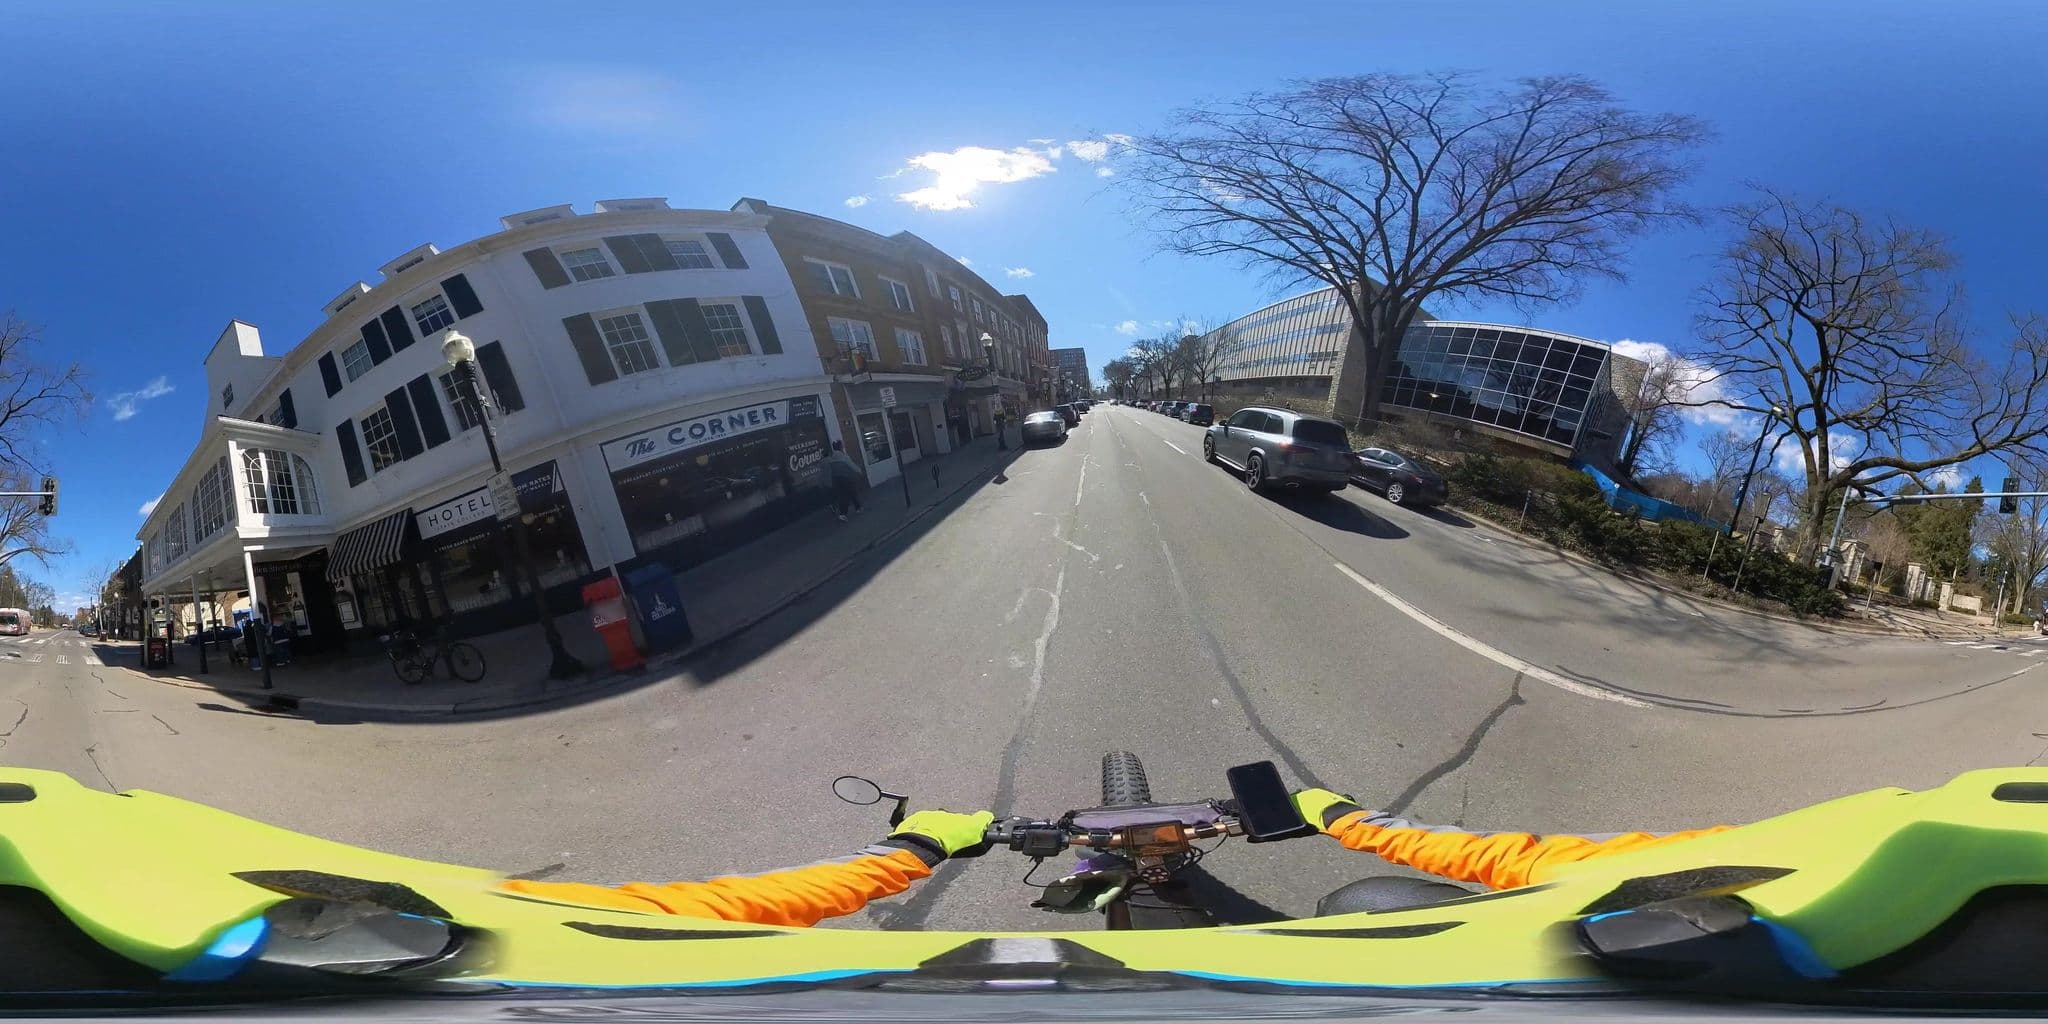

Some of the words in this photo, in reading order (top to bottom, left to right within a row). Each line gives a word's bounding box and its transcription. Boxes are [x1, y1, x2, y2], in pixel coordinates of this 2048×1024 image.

[625, 437, 656, 458] The
[667, 407, 777, 445] CORNER
[789, 447, 824, 472] Corner
[427, 496, 491, 527] HOTEL
